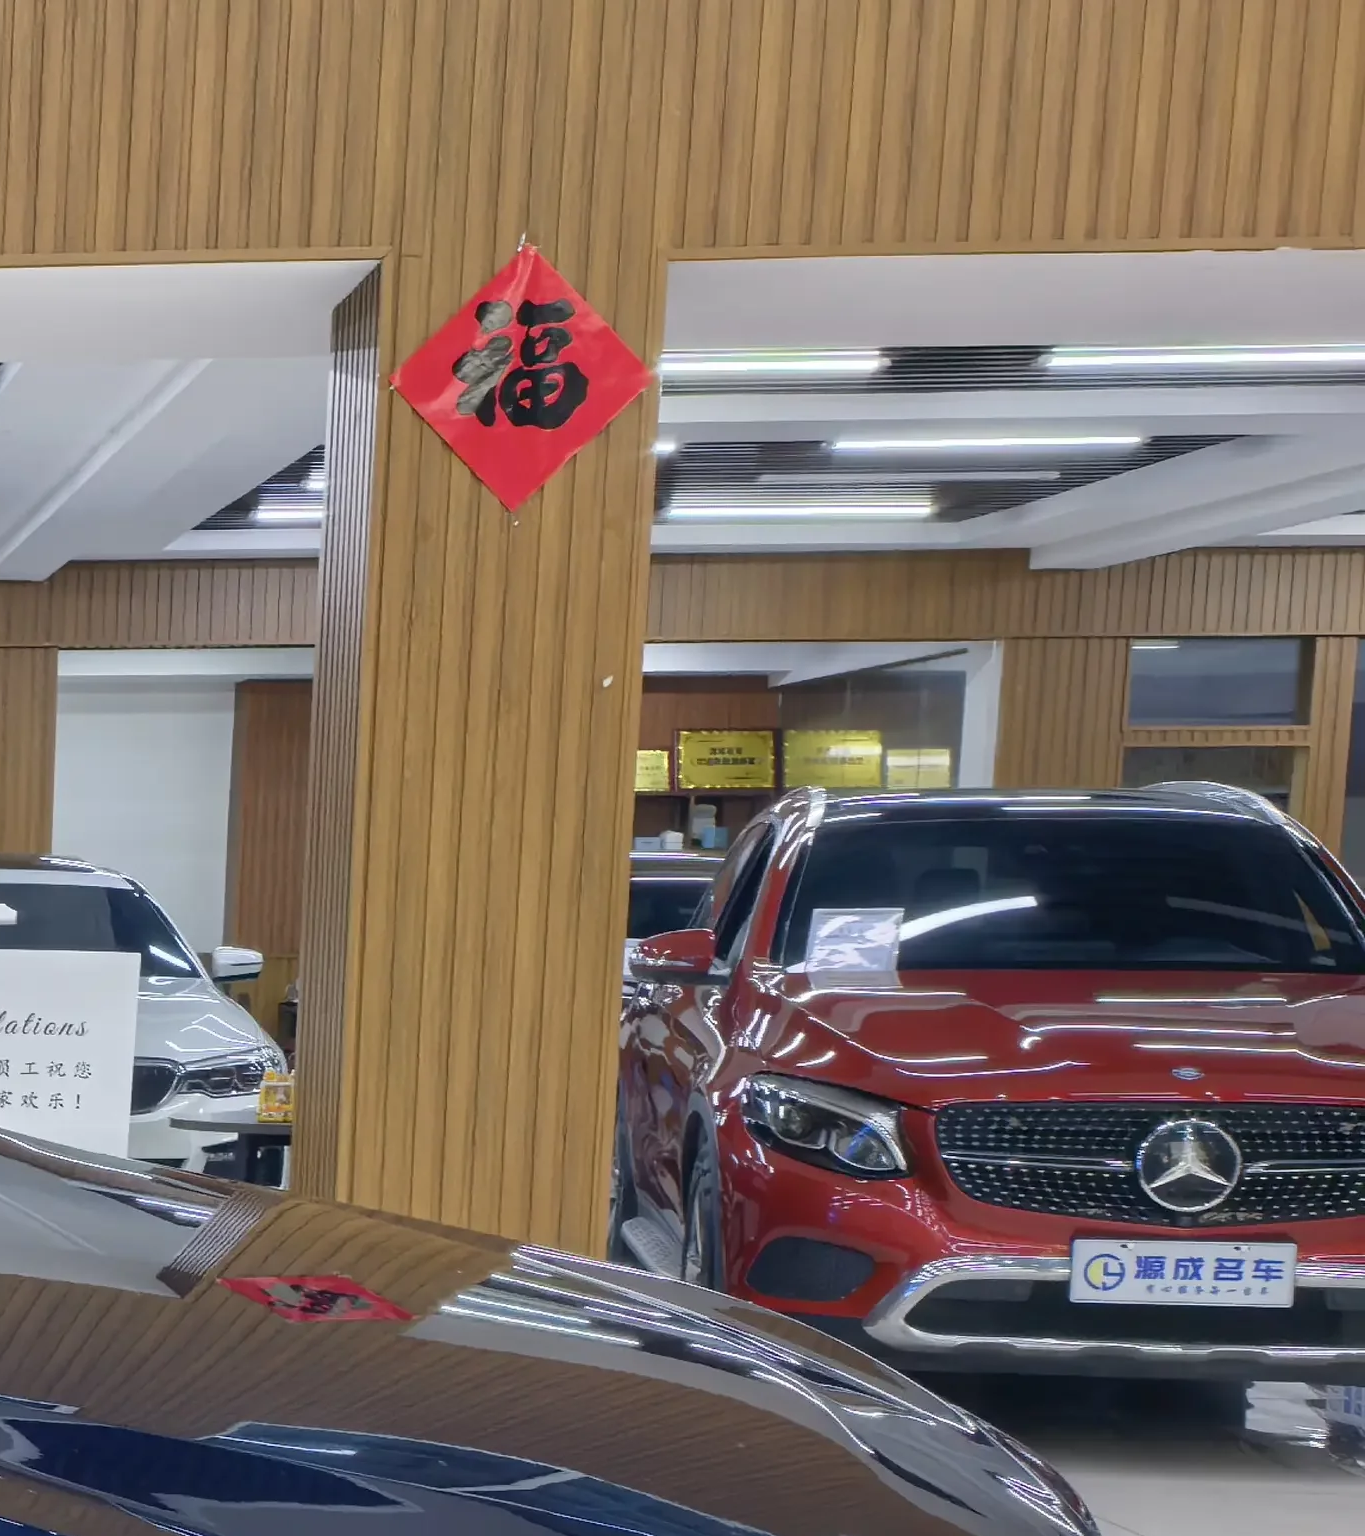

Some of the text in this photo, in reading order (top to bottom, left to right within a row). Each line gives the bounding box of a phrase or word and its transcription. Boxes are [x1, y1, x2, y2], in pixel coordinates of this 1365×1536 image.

[452, 298, 589, 431] 福
[1133, 1255, 1286, 1283] 源成名车
